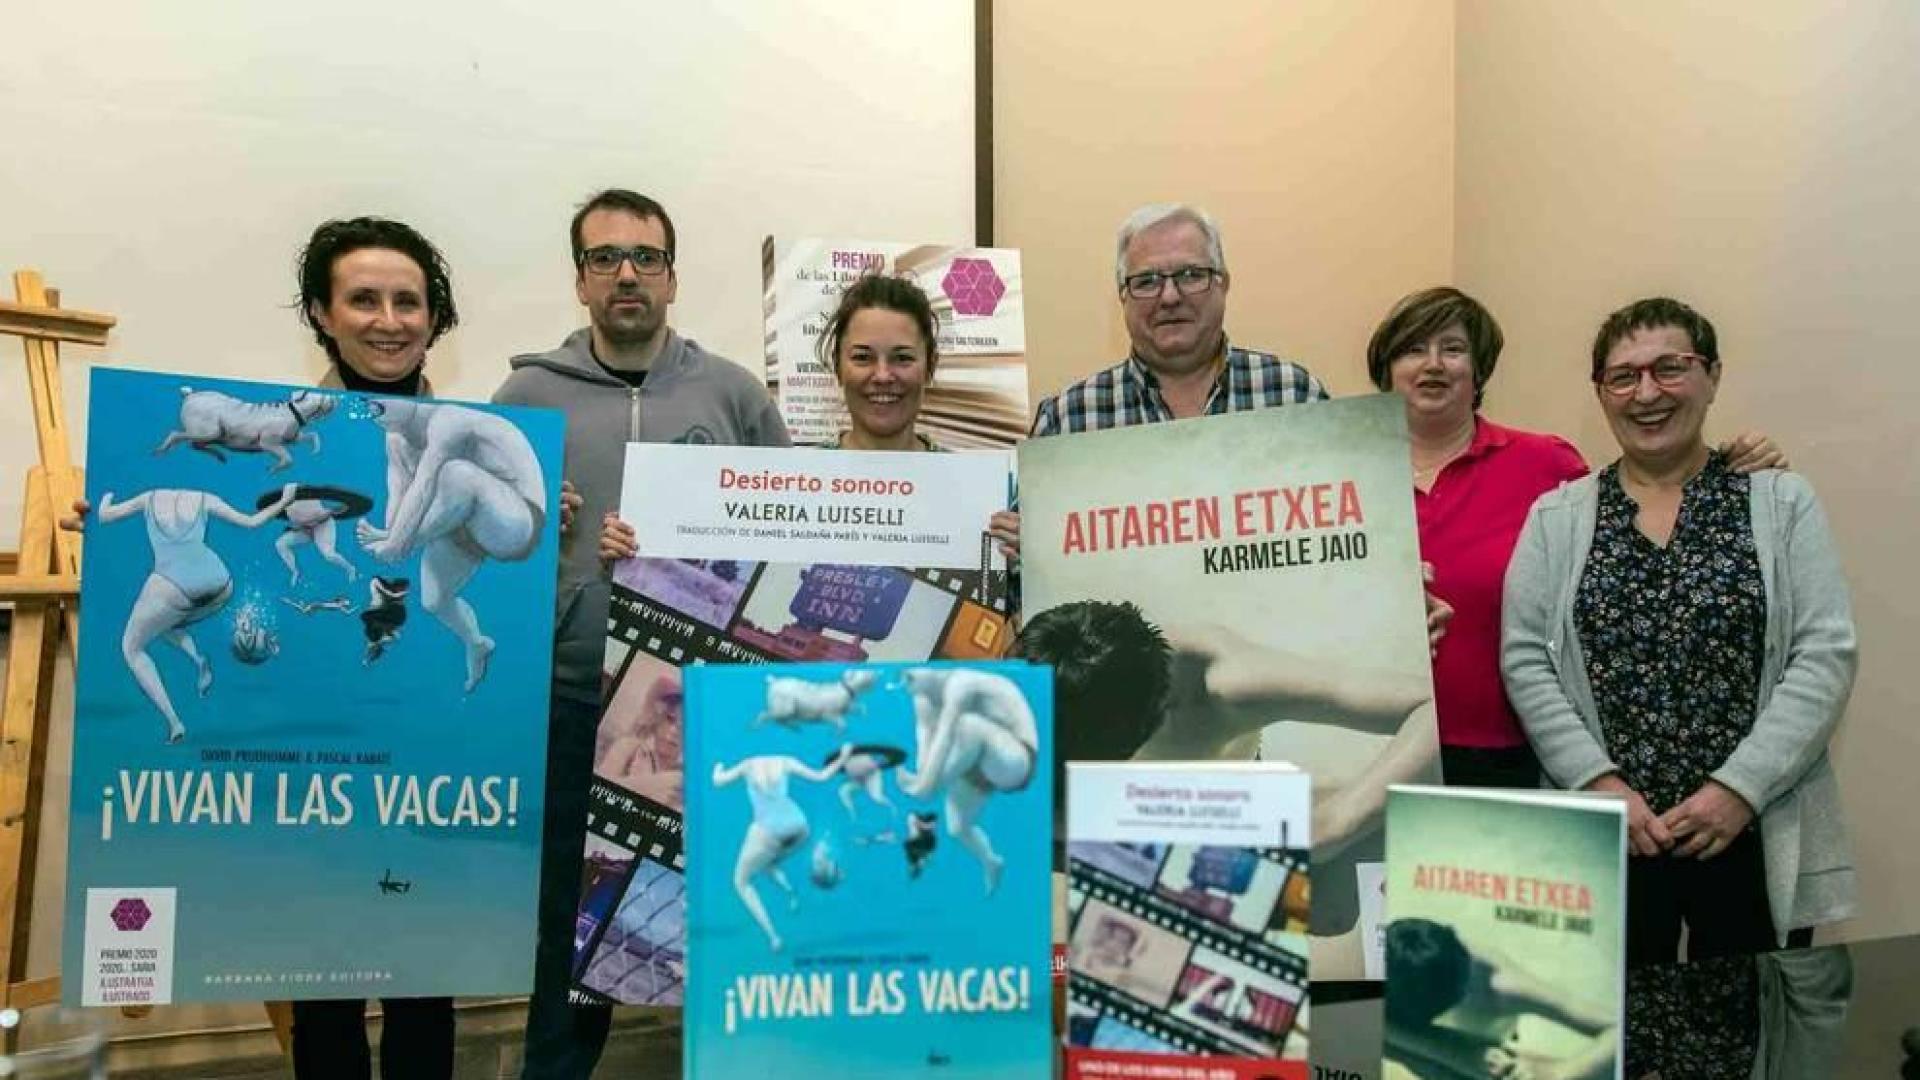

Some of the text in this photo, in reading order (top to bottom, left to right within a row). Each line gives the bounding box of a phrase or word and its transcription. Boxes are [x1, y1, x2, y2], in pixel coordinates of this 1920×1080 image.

[719, 468, 914, 496] Desierto sonoro
[725, 501, 904, 526] VALERIA LUISELLI
[1062, 480, 1364, 555] AITAREN ETXEA
[1203, 531, 1368, 575] KARMELE JAIO
[813, 567, 893, 590] PRESLEY
[806, 599, 864, 622] INN
[101, 769, 519, 840] ¡VIVAN LAS VACAS!
[1413, 864, 1594, 912] AITAREN ETXEA
[1495, 904, 1558, 931] KARMELE
[725, 966, 1030, 1034] ¡VIVAN LAS VACAS!
